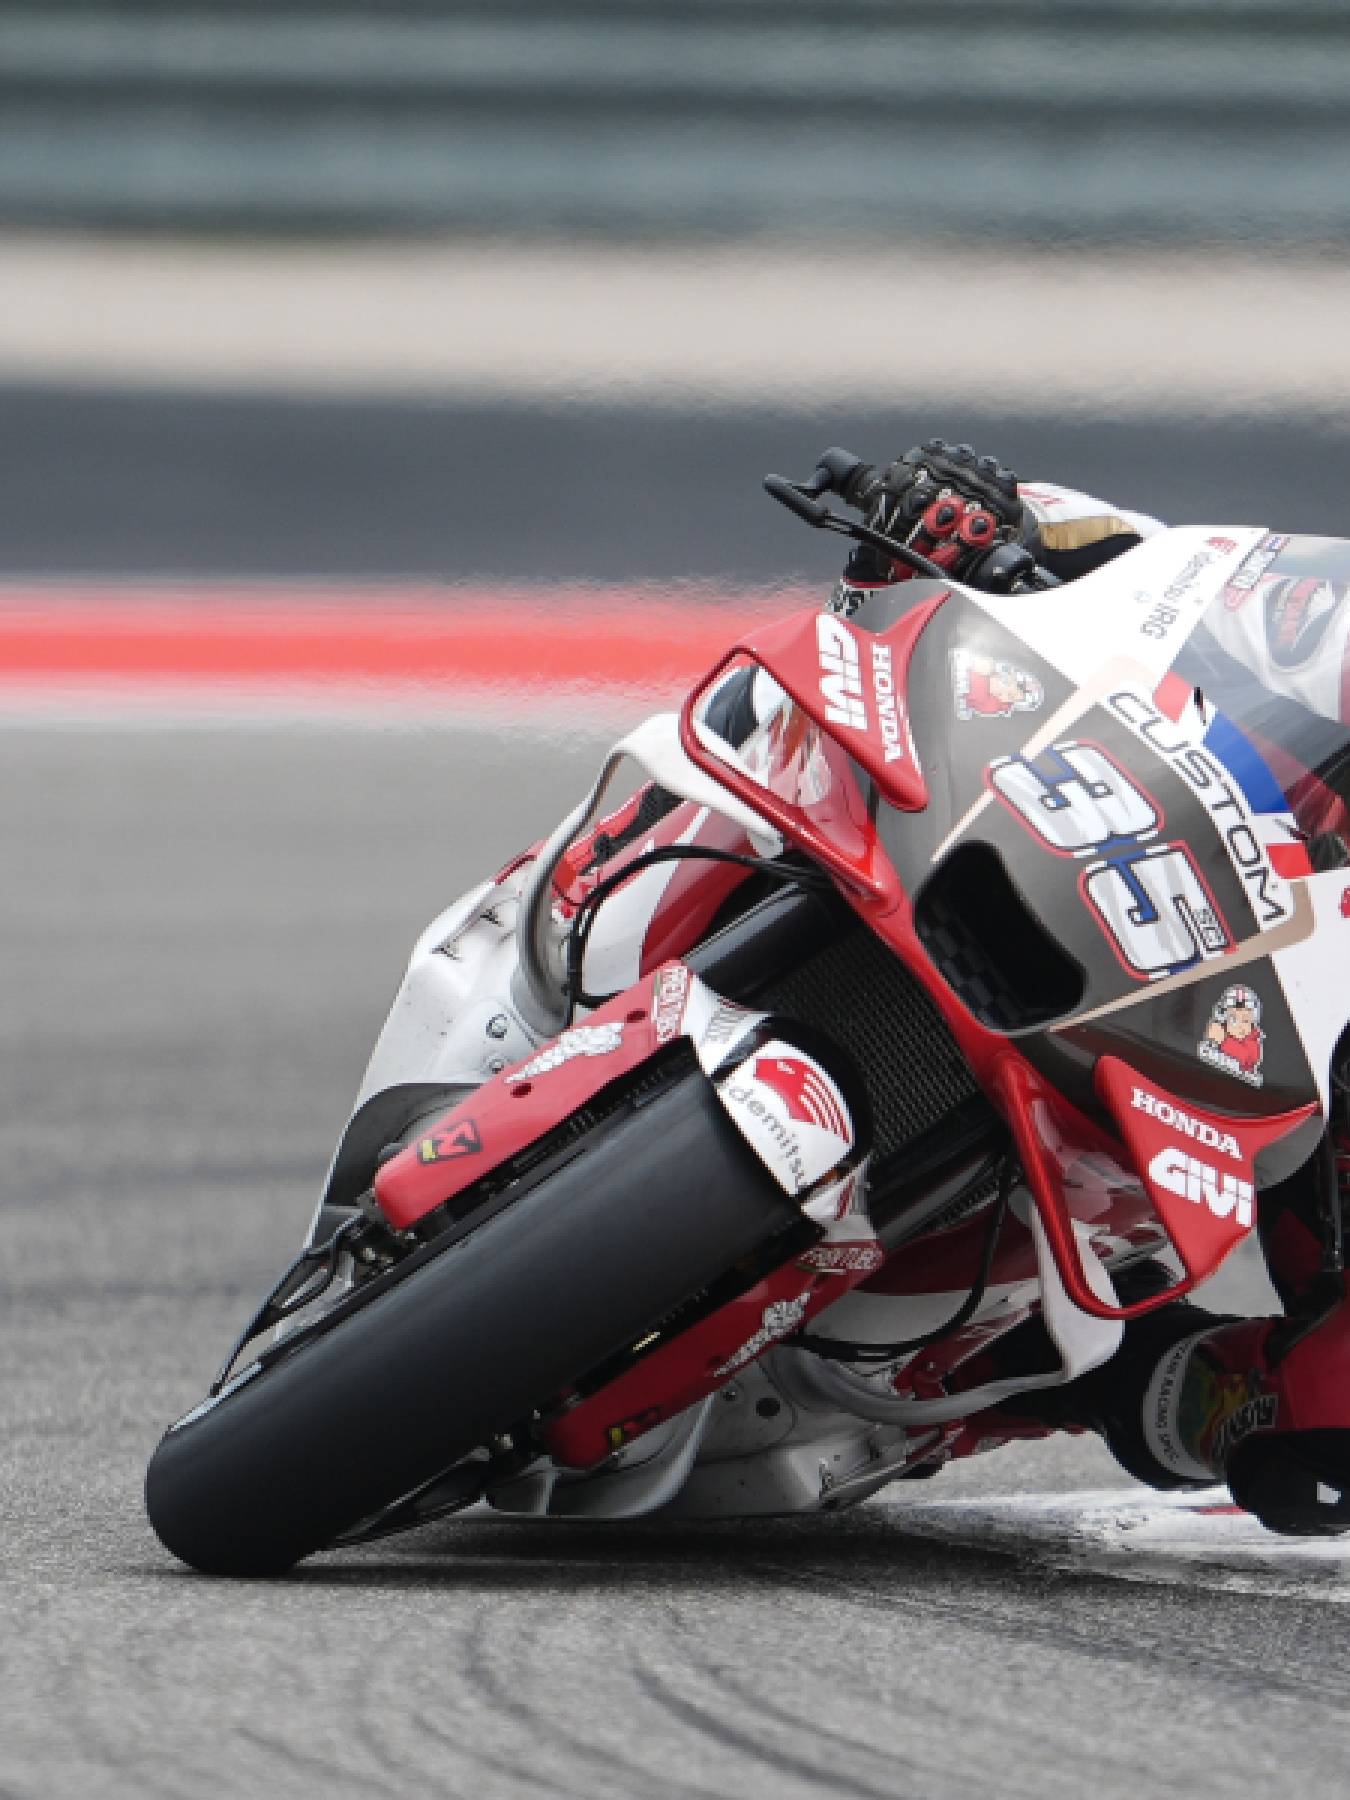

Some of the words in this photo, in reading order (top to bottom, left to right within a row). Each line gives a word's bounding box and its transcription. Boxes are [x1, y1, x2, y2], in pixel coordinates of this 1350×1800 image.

[816, 614, 868, 730] GIVI
[869, 643, 902, 763] HONDA
[984, 739, 1235, 981] 35
[1109, 691, 1286, 922] CUSTOM
[1131, 1087, 1242, 1161] HONDA
[1148, 1146, 1252, 1227] GIVI
